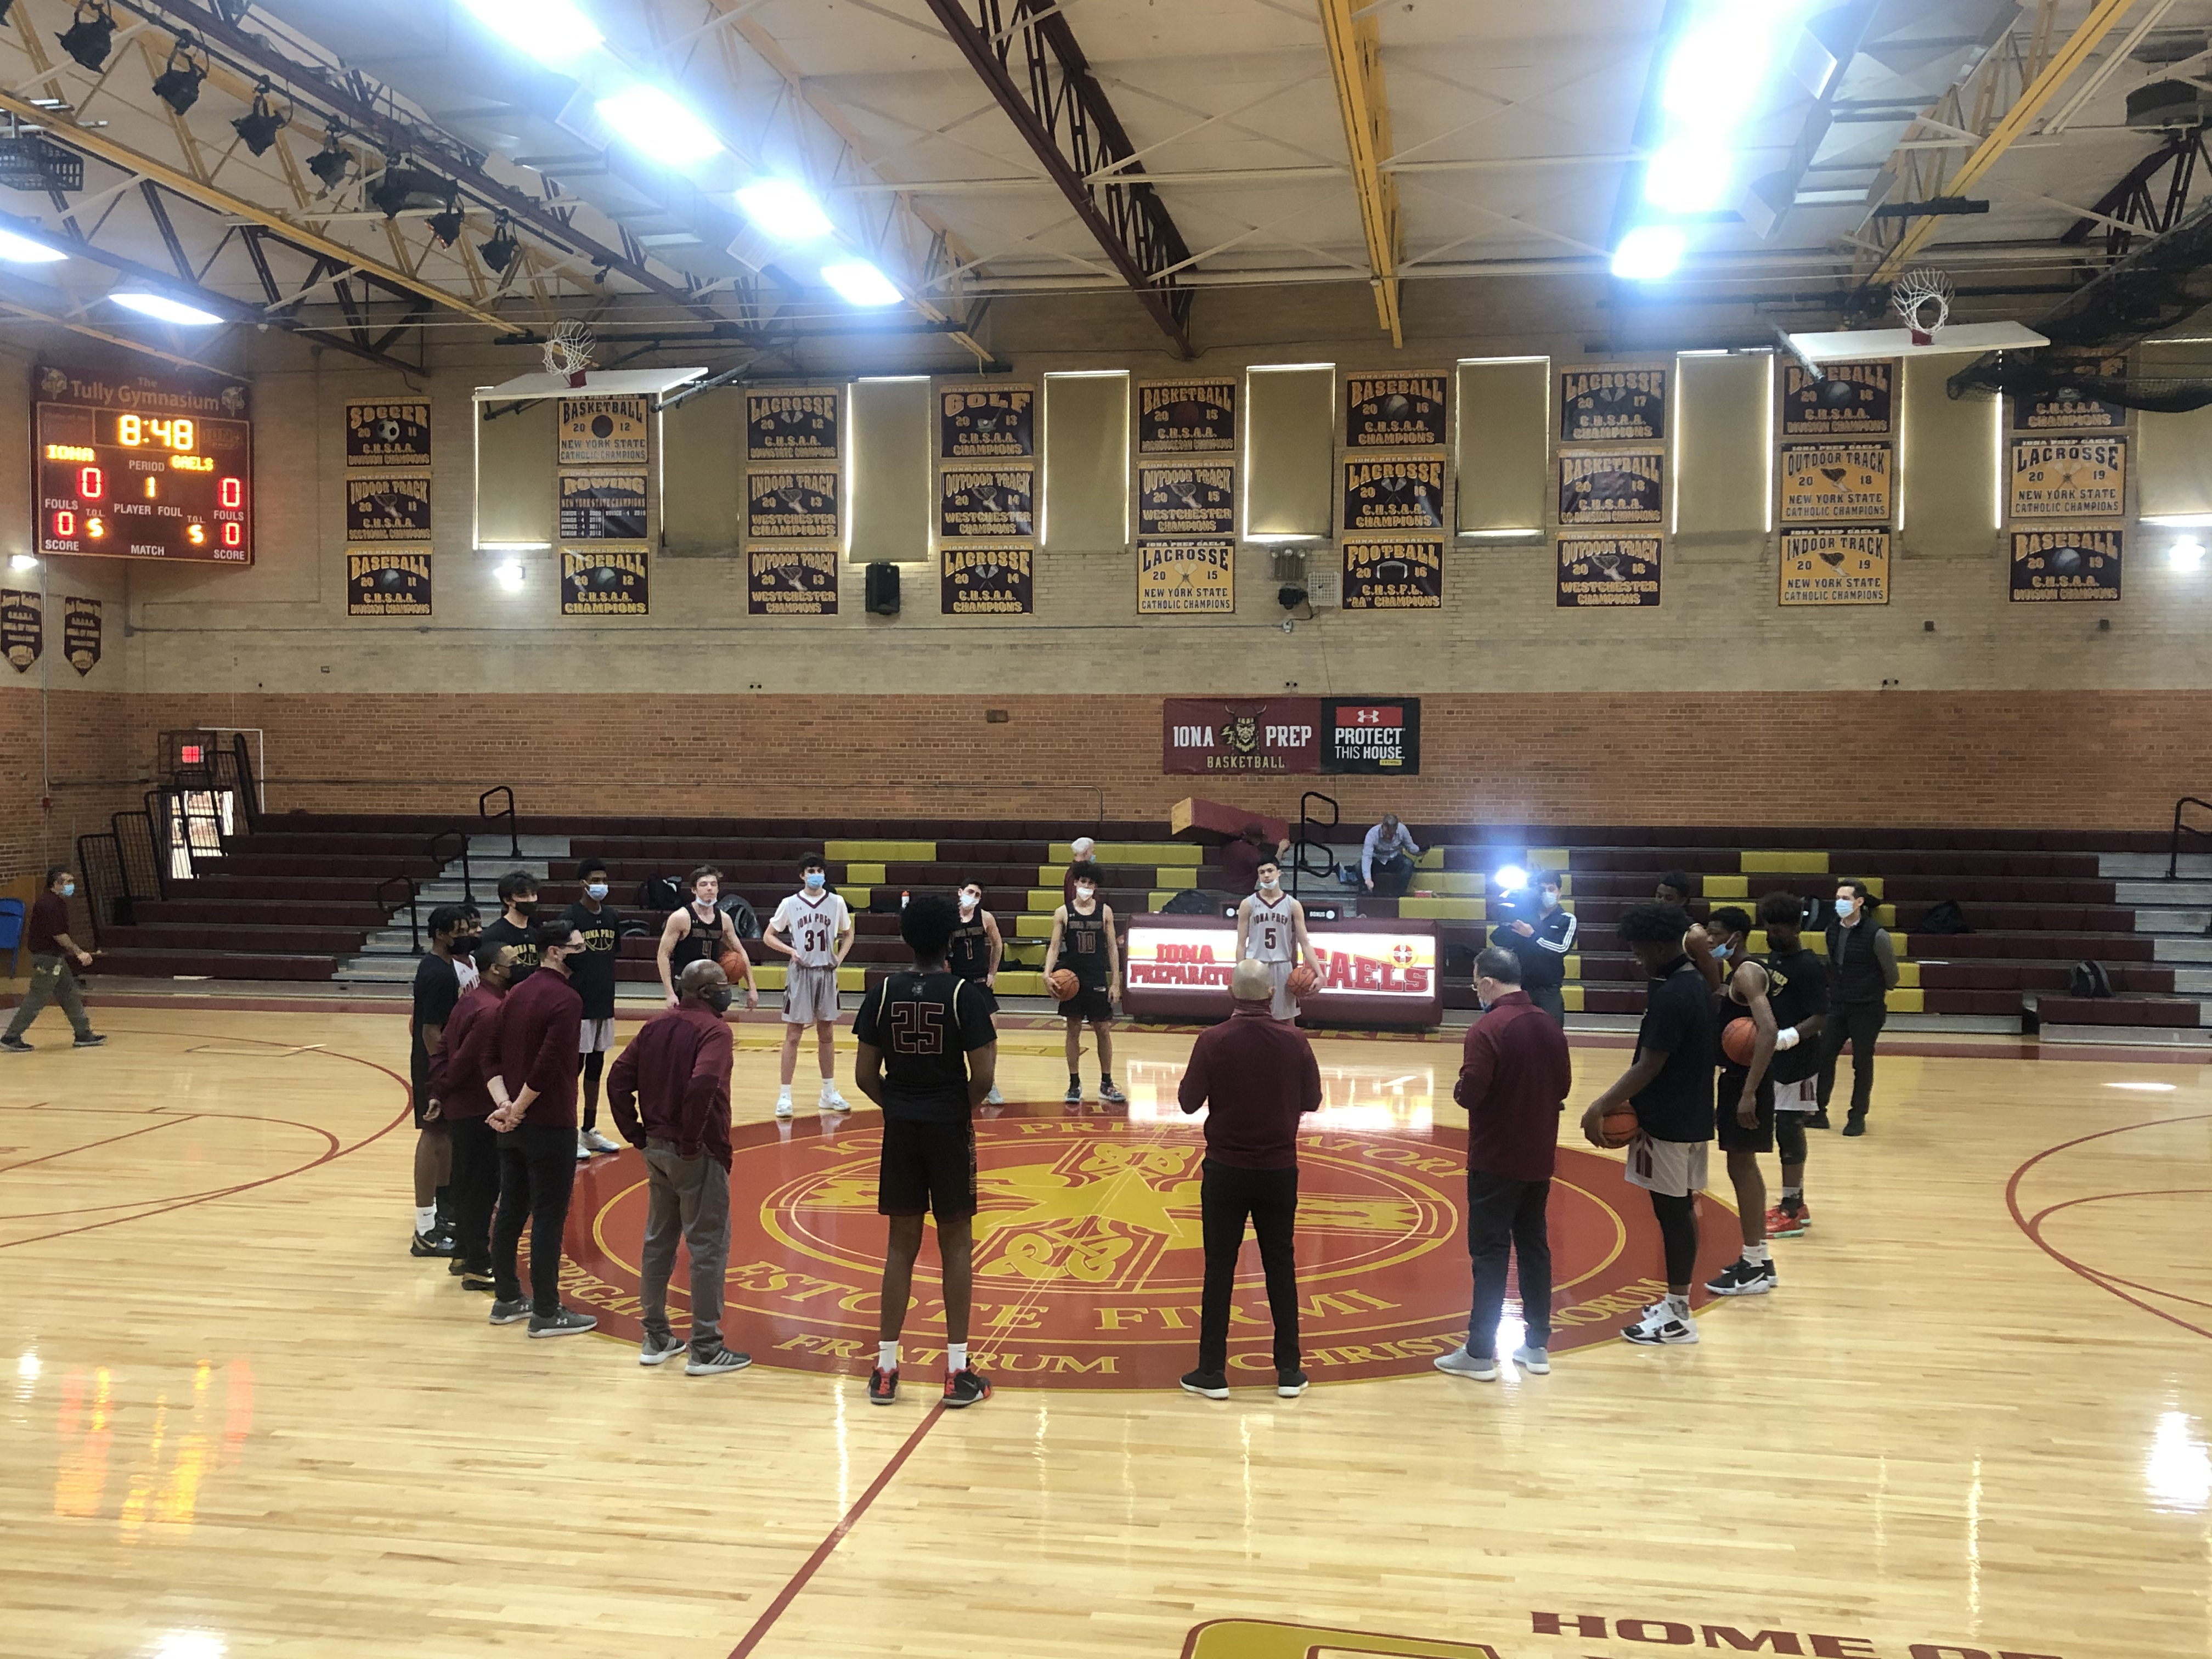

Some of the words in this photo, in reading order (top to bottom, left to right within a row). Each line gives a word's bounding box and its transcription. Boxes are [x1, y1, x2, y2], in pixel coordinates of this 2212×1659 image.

[137, 377, 156, 388] The
[1566, 372, 1662, 401] LACROSSE
[1789, 364, 1888, 395] BAEBALL
[71, 380, 113, 405] Tully
[118, 385, 219, 411] Gymnasium
[1144, 387, 1232, 415] BASKETBALL
[1351, 379, 1443, 408] BASEBALL
[563, 402, 642, 424] BASKETBALL
[751, 397, 834, 424] LACROSSE
[945, 393, 1030, 417] GOLF
[350, 406, 428, 430] SOCCER
[119, 414, 194, 451] 8:48
[573, 424, 585, 432] 20
[620, 422, 630, 431] 12
[561, 440, 581, 448] NEW
[614, 439, 645, 448] STATE
[47, 445, 95, 462] IONA
[561, 452, 597, 460] CATHOLIC
[601, 450, 645, 459] CHAMPIONS
[2017, 446, 2118, 473] LACROSSE
[129, 460, 165, 472] PERIOD
[1564, 456, 1659, 486] BASKETBALL
[1788, 453, 1841, 476] OUTDOOR
[1846, 452, 1884, 475] TRACK
[80, 467, 103, 498] 0
[1144, 470, 1192, 494] OUTDOOR
[1195, 469, 1231, 493] TRACK
[1349, 463, 1441, 492] LACROSSE
[1799, 477, 1813, 486] 20
[1860, 475, 1872, 484] 18
[2029, 472, 2044, 481] 20
[2094, 470, 2105, 480] 19
[146, 476, 156, 498] 1
[222, 478, 241, 508] 0
[351, 481, 390, 505] INDOOR
[392, 481, 427, 503] TRACK
[564, 477, 645, 495] ROWING
[752, 476, 793, 501] INDOOR
[796, 475, 834, 500] TRACK
[946, 473, 993, 497] OUTDOOR
[996, 473, 1030, 497] TRACK
[1359, 487, 1375, 498] 20
[1414, 486, 1426, 496] 16
[1789, 495, 1812, 504] NEW
[1816, 494, 1843, 503] YORK
[1848, 494, 1882, 503] STATE
[2019, 490, 2042, 500] NEW
[2047, 490, 2075, 499] YORK
[2080, 489, 2115, 499] STATE
[45, 498, 78, 510] FOULS
[114, 504, 151, 515] PLAYER
[158, 506, 183, 517] FOUL
[1362, 504, 1426, 515] C.H.S.A.A.
[1786, 506, 1829, 517] CATHOLIC
[1833, 505, 1885, 516] CHAMPIONS
[2016, 503, 2061, 512] CATHOLIC
[2064, 501, 2118, 512] CHAMPIONS
[86, 509, 105, 517] T.O.L.
[187, 515, 206, 524] T.O.L.
[213, 510, 244, 521] FOULS
[752, 514, 836, 524] WESTCHESTER
[57, 511, 75, 536] 0
[751, 525, 836, 536] CHAMPIONS
[1356, 516, 1432, 528] CHAMPIONS
[224, 522, 240, 545] 0
[45, 539, 79, 551] SCORE
[131, 545, 165, 556] MATCH
[1562, 541, 1616, 567] OUTDOOR
[1619, 540, 1657, 566] TRACK
[1787, 538, 1835, 561] INDOOR
[1841, 537, 1883, 560] TRACK
[2016, 533, 2118, 561] BASEBALL
[213, 549, 245, 560] SCORE
[1143, 549, 1228, 572] LACROSSE
[1347, 545, 1439, 572] FOOTBALL
[351, 556, 428, 580] BASEBALL
[565, 555, 645, 579] BASEBALL
[752, 553, 799, 577] OUTDOOR
[800, 553, 834, 577] TRACK
[945, 551, 1030, 577] LACROSSE
[1356, 568, 1372, 578] 20
[1414, 567, 1427, 578] 16
[1797, 561, 1812, 570] 20
[1859, 560, 1870, 569] 19
[574, 575, 588, 586] 20
[623, 575, 634, 585] 12
[955, 573, 968, 584] 20
[1007, 573, 1019, 583] 14
[1153, 571, 1166, 580] 20
[1207, 571, 1217, 579] 15
[1788, 579, 1810, 588] NEW
[1815, 579, 1842, 588] YORK
[1847, 578, 1881, 587] STATE
[958, 590, 1016, 601] C.H.S.A.A.
[1144, 589, 1164, 597] NEW
[1168, 588, 1192, 597] YORK
[1197, 588, 1227, 597] STATE
[1362, 584, 1423, 596] C.H.S.F.L.
[1561, 582, 1658, 592] WESTCHESTER
[1785, 591, 1828, 601] CATHOLIC
[1832, 590, 1883, 600] CHAMPIONS
[565, 602, 646, 613] CHAMPIONS
[953, 601, 1023, 612] CHAMPIONS
[1142, 600, 1180, 609] CATHOLIC
[1184, 600, 1230, 608] CHAMPIONS
[1374, 595, 1440, 607] CHAMPIONS
[1173, 726, 1214, 747] IONA
[1265, 726, 1312, 747] PREP
[1335, 728, 1403, 744] PROTECT
[1335, 747, 1360, 759] THIS
[1207, 756, 1285, 769] BASKETBALL
[797, 915, 812, 930] IONA
[815, 913, 831, 928] PREP
[1253, 913, 1269, 926] IONA
[1272, 913, 1288, 925] PREP
[804, 929, 825, 952] 31
[1076, 931, 1096, 953] 10
[1265, 928, 1276, 950] 5
[964, 938, 973, 960] 1
[1155, 944, 1215, 964] IONA
[1130, 964, 1233, 986] PREPARATO
[891, 1001, 945, 1054] 25
[772, 1334, 1120, 1374] FRATRUM
[1531, 1611, 1882, 1659] HOME
